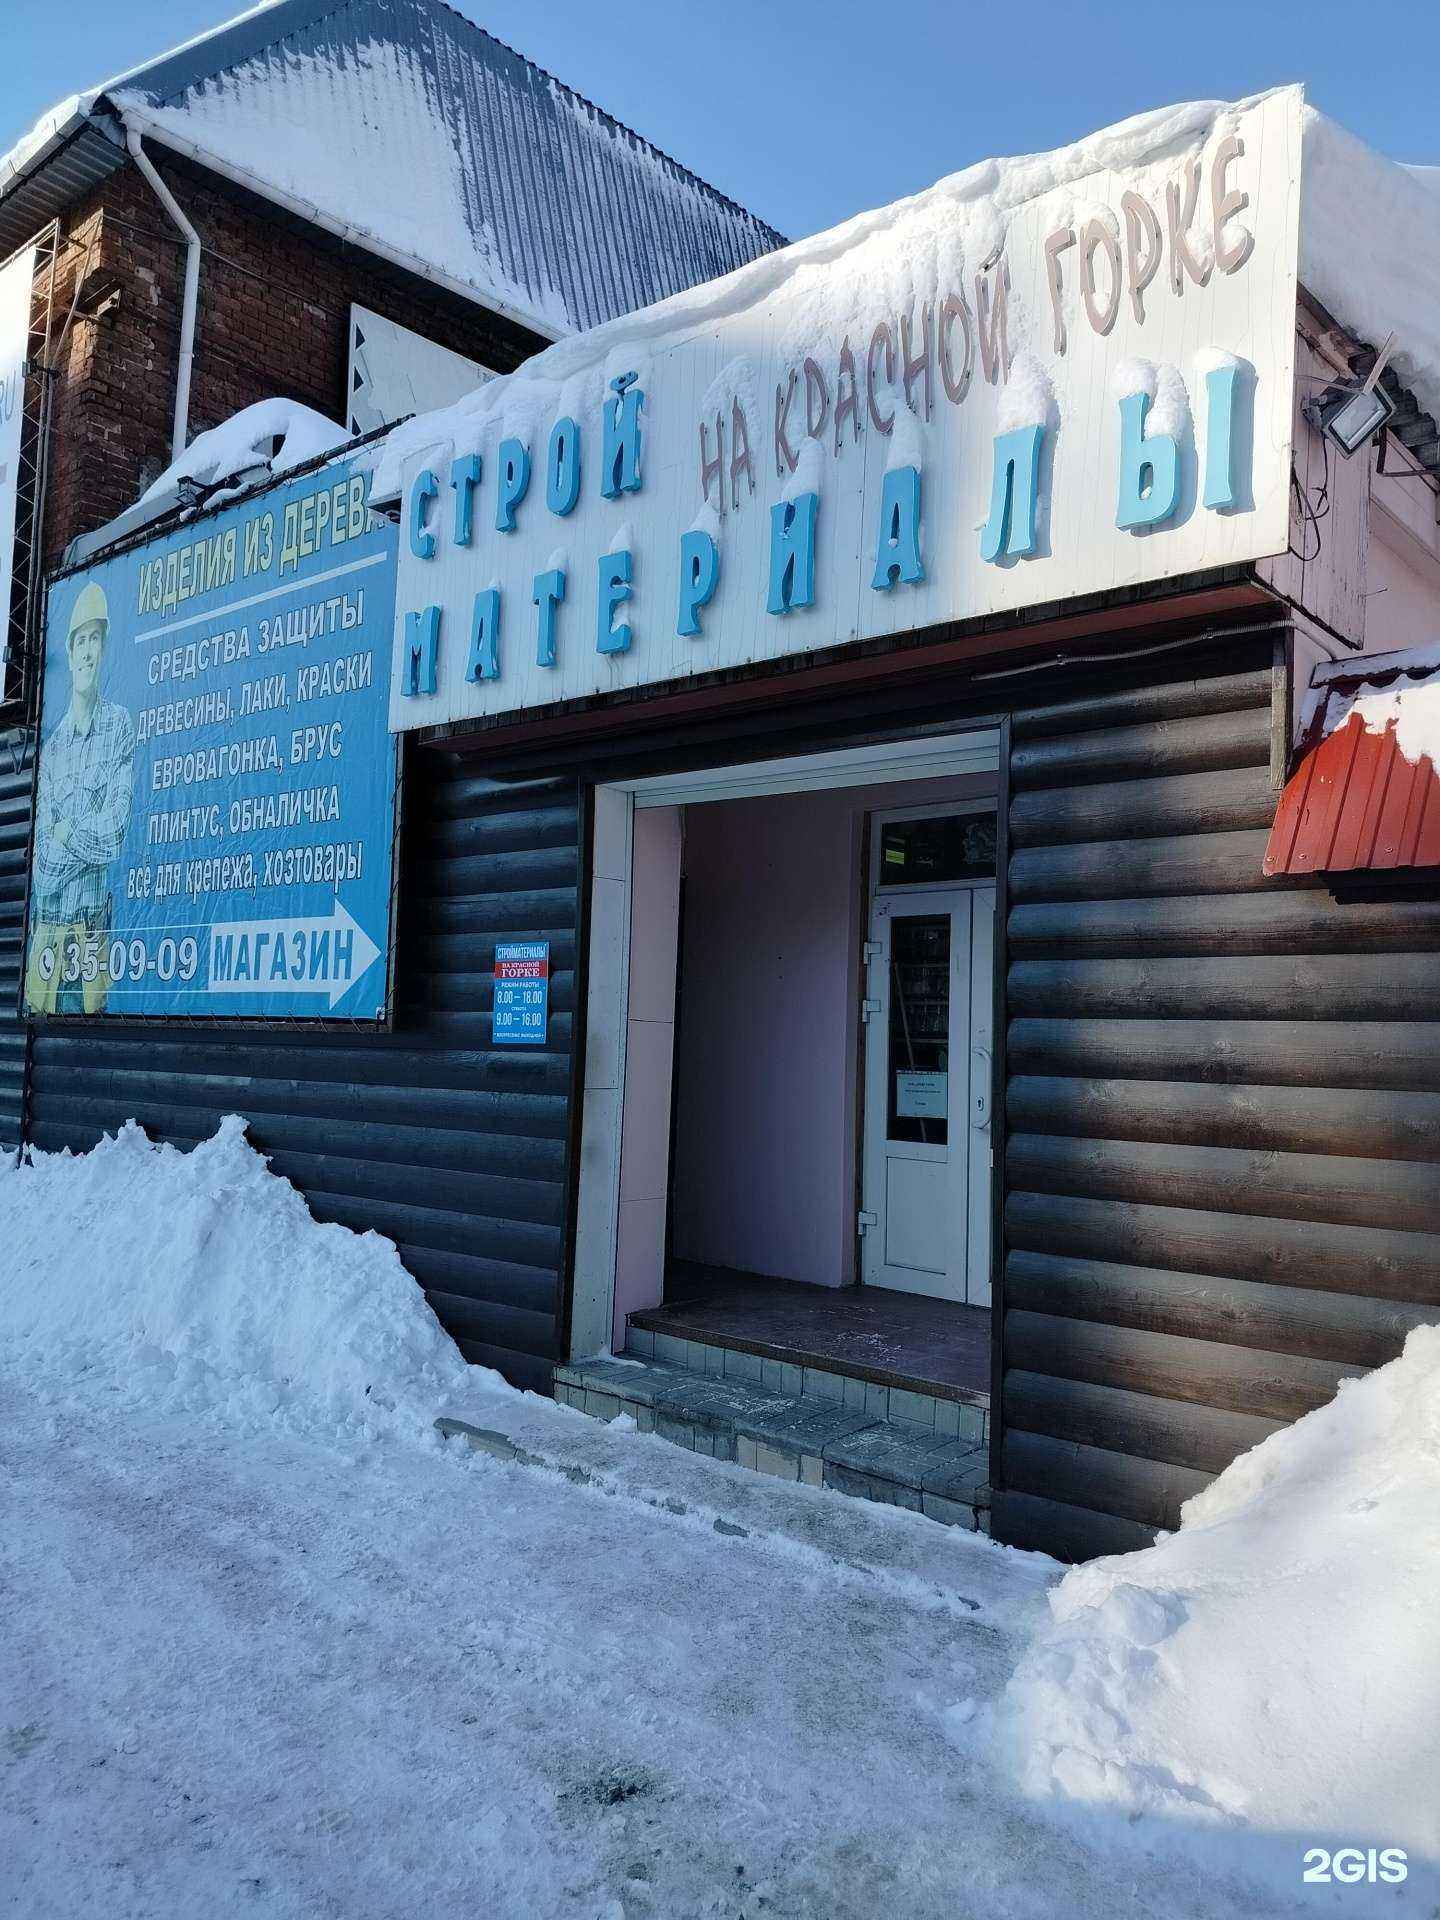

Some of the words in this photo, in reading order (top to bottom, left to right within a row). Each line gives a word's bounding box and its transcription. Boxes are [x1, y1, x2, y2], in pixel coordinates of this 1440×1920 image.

[700, 395, 756, 524] НА
[776, 240, 1011, 478] КРАСНОЙ
[1044, 135, 1255, 357] ГОРКЕ
[410, 370, 645, 560] СТРОЙ
[137, 527, 237, 618] ИЗДЕЛИЯ
[242, 511, 275, 577] ИЗ
[401, 366, 1240, 697] МАТЕРИАЛЫ
[148, 626, 251, 686] СРЕДСТВА
[257, 588, 364, 653] ЗАЩИТЫ
[136, 686, 235, 746] ДРЕВЕСИНЫ,
[239, 673, 291, 717] ЛАКИ,
[297, 651, 372, 703] КРАСКИ
[152, 735, 283, 791] ЕВРОВАГОНКА,
[290, 721, 343, 765] БРУС
[148, 804, 225, 845] ПЛИНТУС,
[229, 785, 341, 834] ОБНАЛИЧКА
[127, 857, 152, 899] всё
[154, 862, 181, 905] для
[185, 852, 258, 905] крепежа,
[262, 841, 364, 894] хозтовары
[63, 935, 199, 983] 35-09-09
[212, 928, 355, 982] МАГАЗИН
[497, 945, 546, 959] СТРОЙМАТЕРИАЛЫ
[501, 967, 540, 978] ГОРКЕ
[496, 1012, 513, 1026] 9.00
[521, 1012, 542, 1026] 16.00
[497, 990, 514, 1004] 8.00
[523, 990, 543, 1004] 18.00
